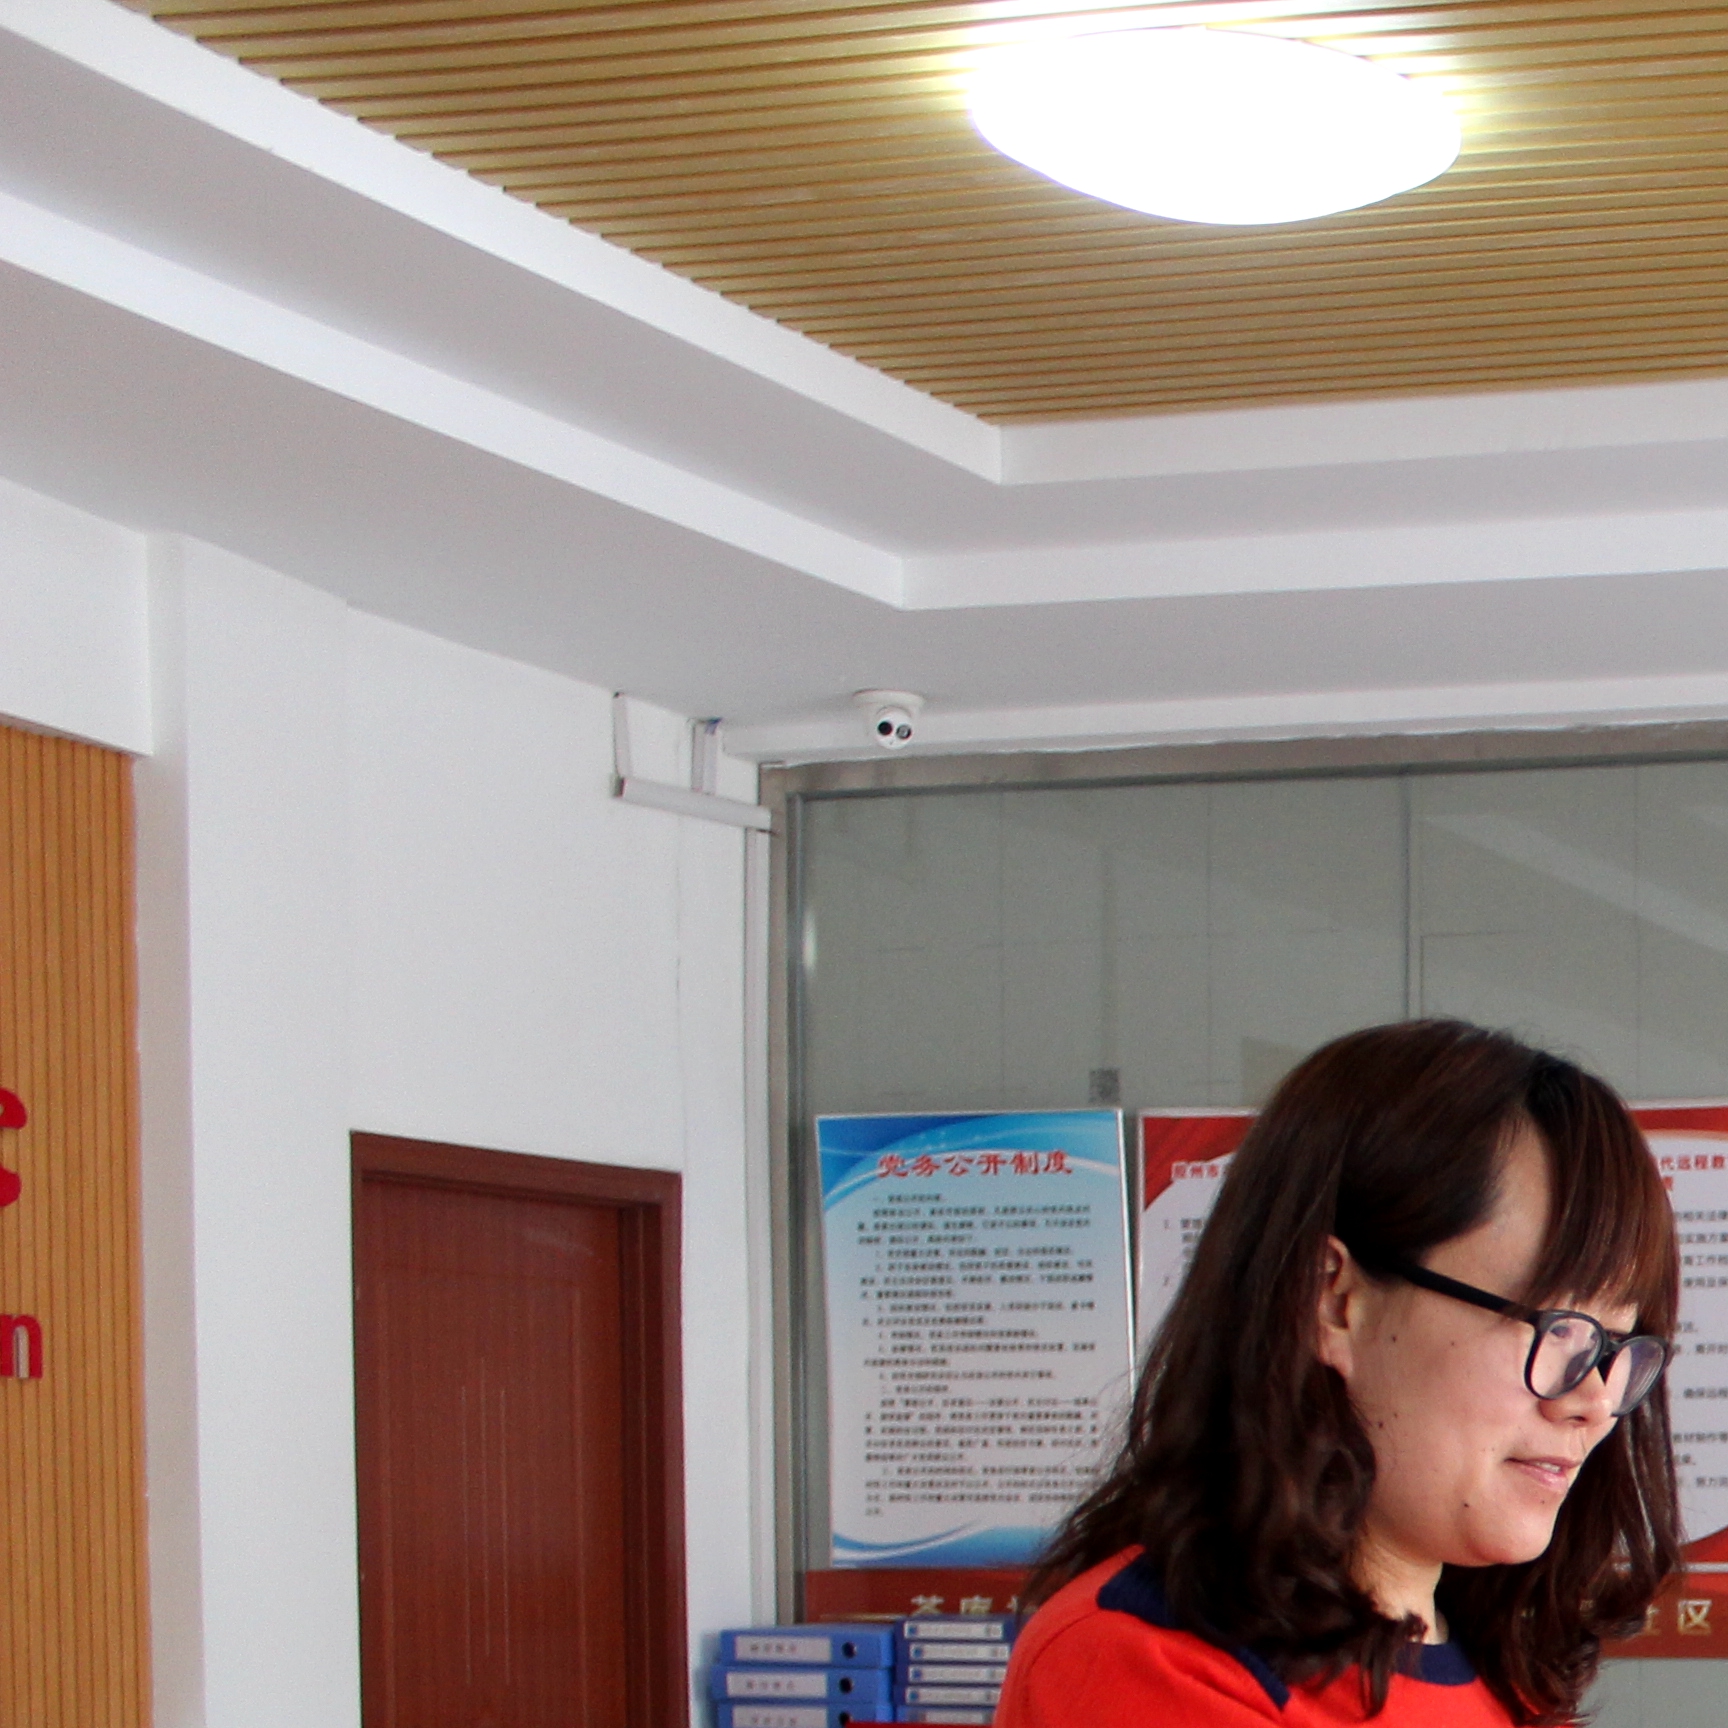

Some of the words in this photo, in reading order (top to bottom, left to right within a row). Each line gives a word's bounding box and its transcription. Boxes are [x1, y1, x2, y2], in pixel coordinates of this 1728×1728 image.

[877, 1150, 1073, 1178] 党务公开制度
